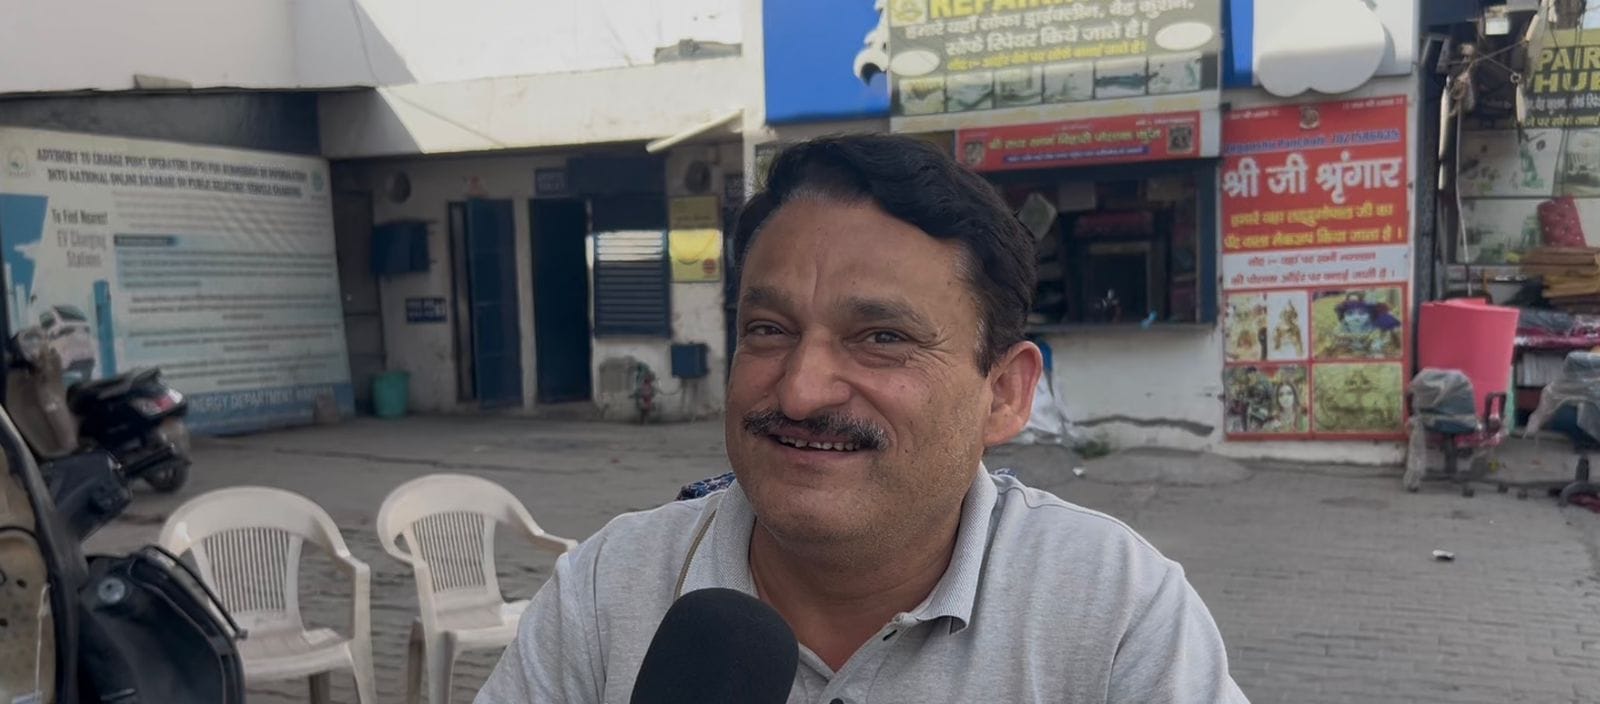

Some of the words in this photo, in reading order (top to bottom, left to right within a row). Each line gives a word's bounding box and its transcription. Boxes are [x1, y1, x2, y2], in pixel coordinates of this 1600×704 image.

[905, 20, 944, 39] हमारे
[987, 31, 1038, 51] रिपेयर
[1081, 19, 1121, 40] जाते
[1223, 157, 1260, 198] श्री
[1265, 152, 1308, 195] जी
[52, 209, 61, 224] To
[62, 209, 78, 224] Find
[80, 210, 108, 225] Nearest
[1230, 211, 1260, 228] हमारे
[1356, 201, 1373, 217] जी
[1376, 203, 1394, 217] का
[57, 229, 68, 248] EV
[70, 230, 106, 250] Charging
[1350, 228, 1380, 242] जाता
[66, 251, 102, 268] Stations
